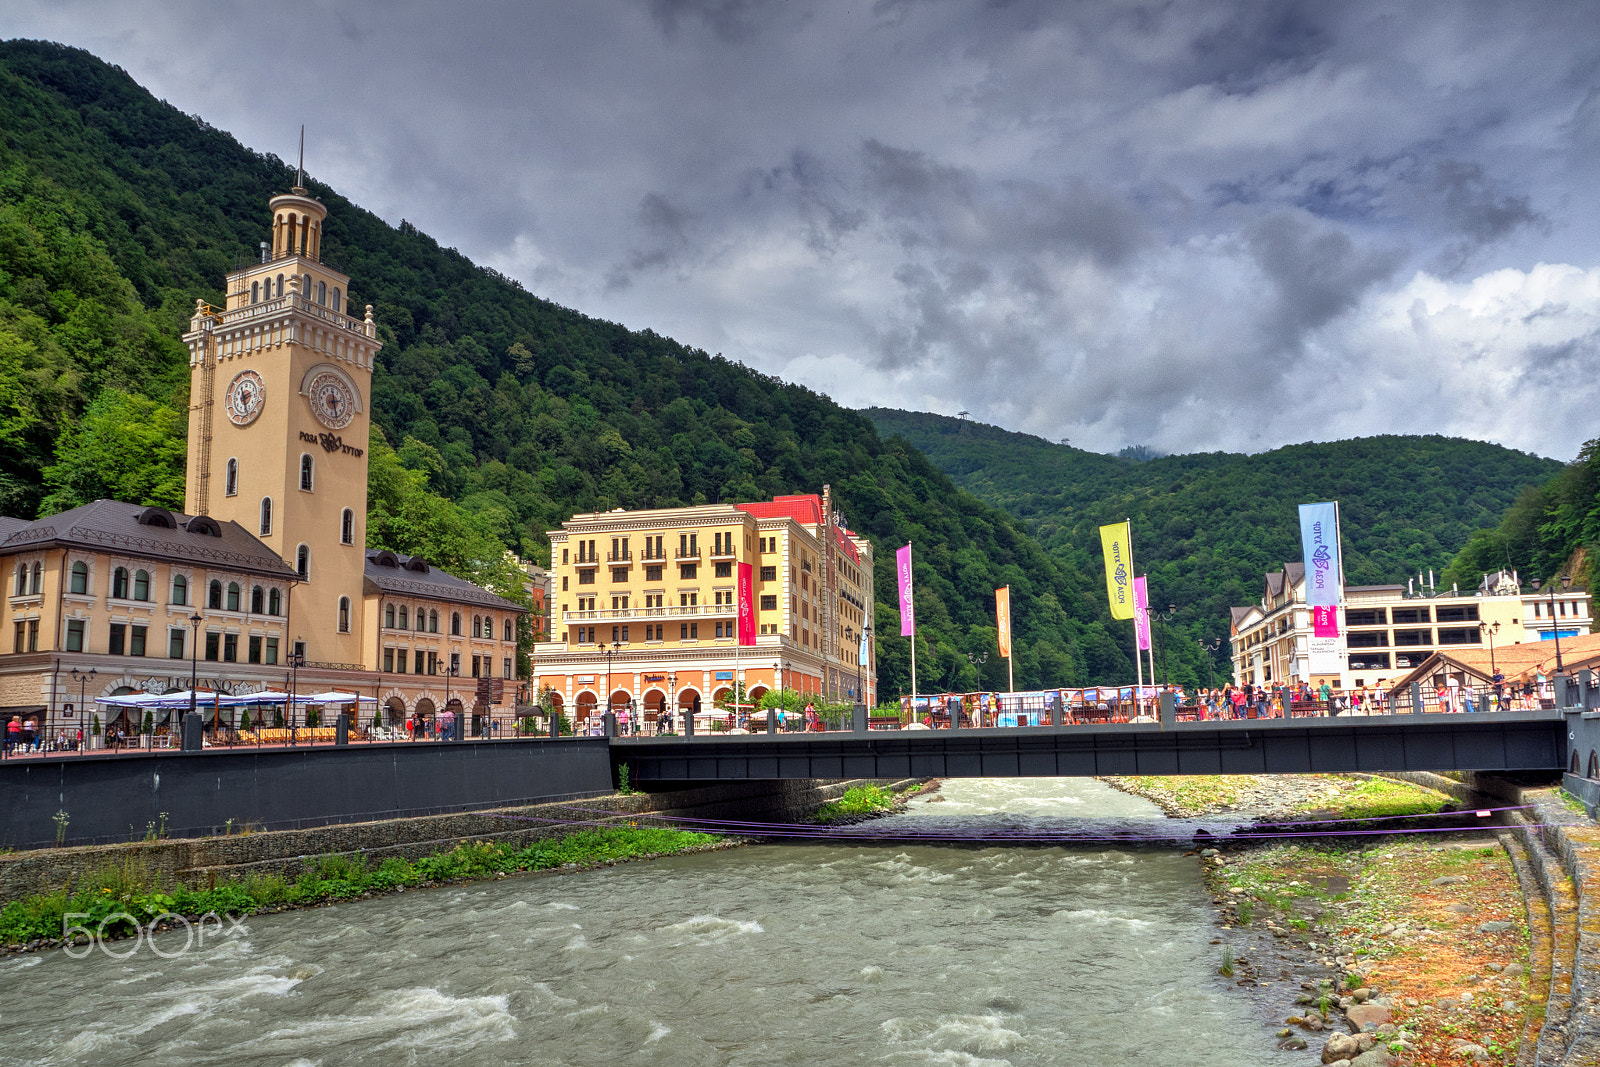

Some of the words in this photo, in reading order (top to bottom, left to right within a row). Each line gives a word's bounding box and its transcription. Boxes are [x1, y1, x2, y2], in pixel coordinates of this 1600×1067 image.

[299, 430, 318, 445] РОЗА
[342, 444, 364, 458] ХУТОР
[167, 677, 231, 692] LUCIANO
